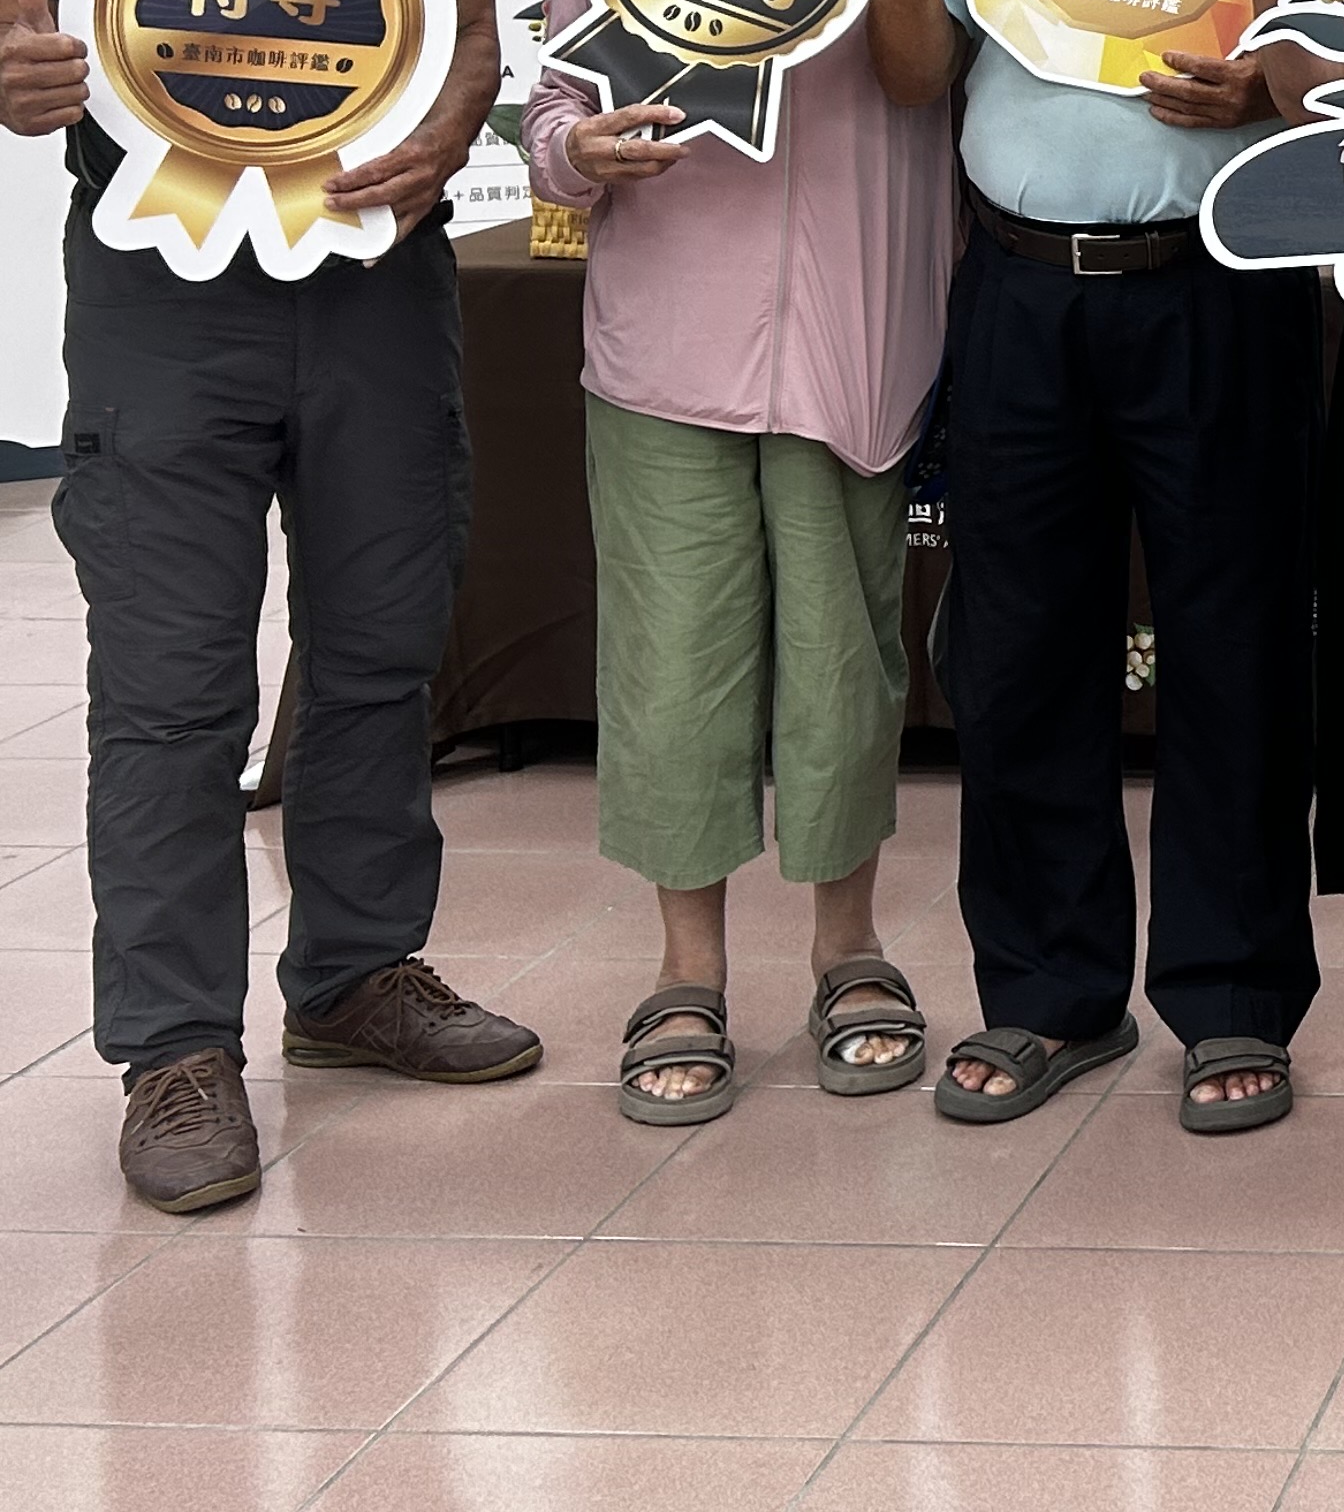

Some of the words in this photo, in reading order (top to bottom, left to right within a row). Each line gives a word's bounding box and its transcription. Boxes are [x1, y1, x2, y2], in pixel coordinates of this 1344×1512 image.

[182, 42, 330, 72] 臺南市咖啡評鑑
